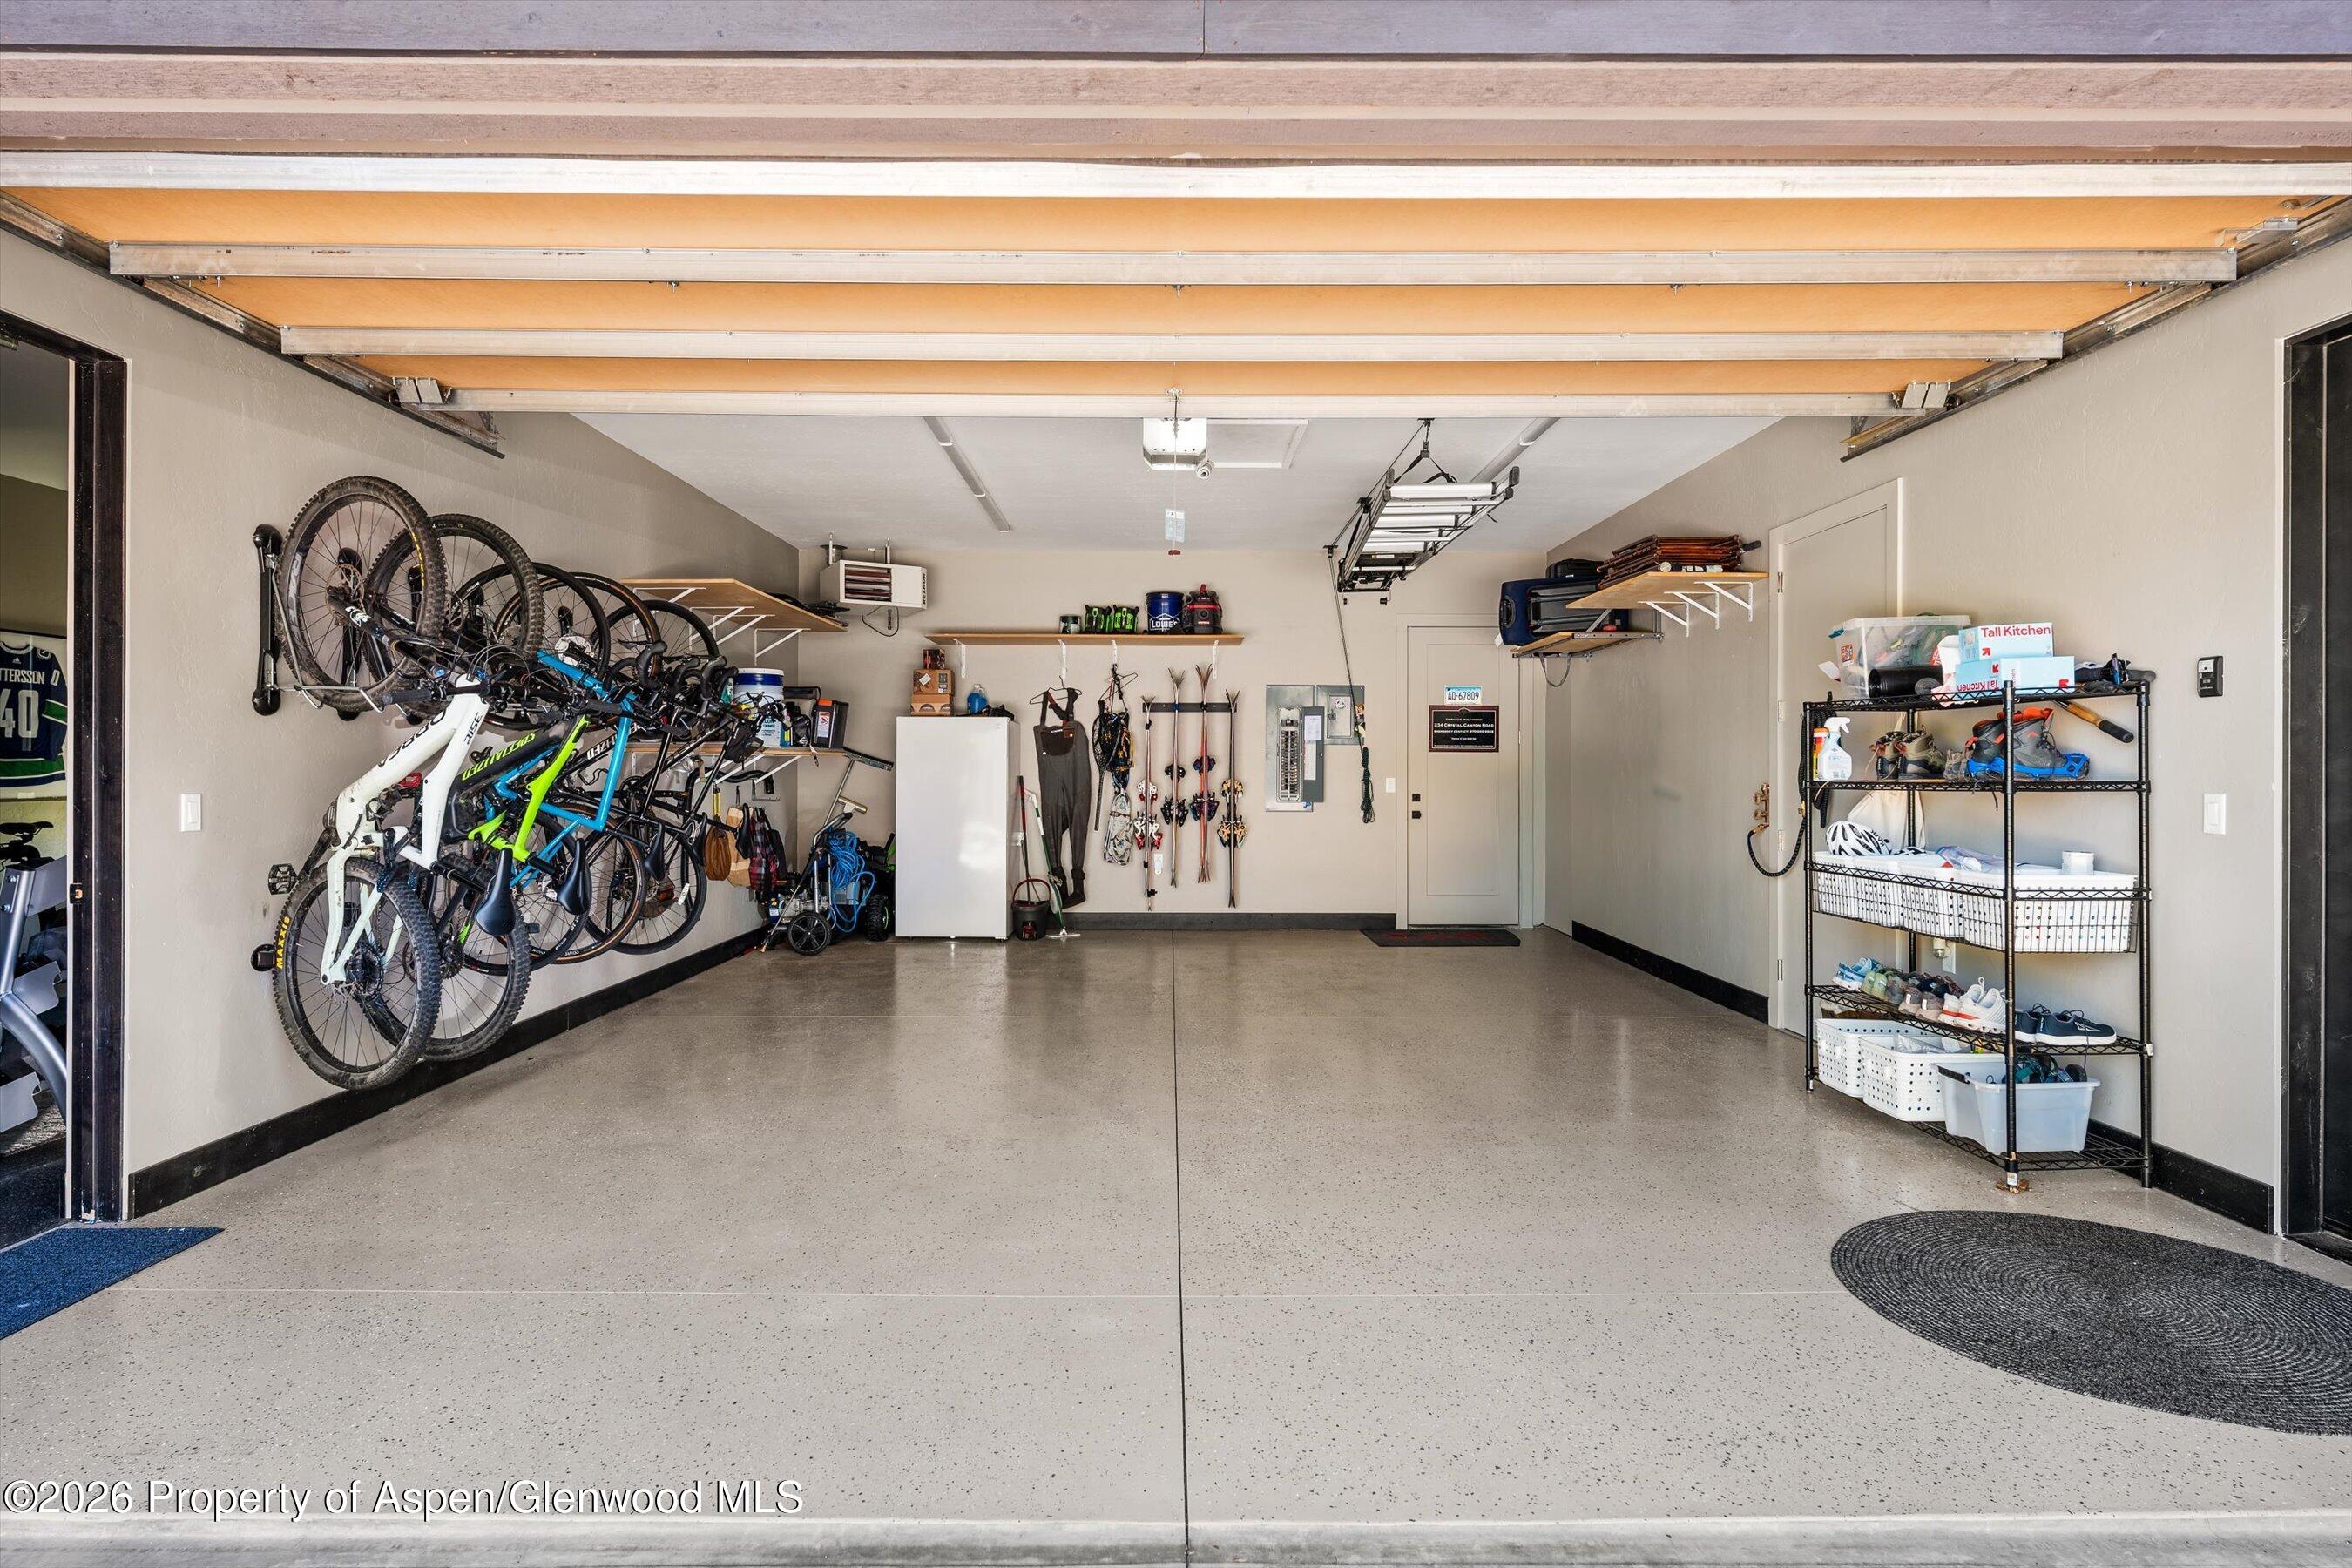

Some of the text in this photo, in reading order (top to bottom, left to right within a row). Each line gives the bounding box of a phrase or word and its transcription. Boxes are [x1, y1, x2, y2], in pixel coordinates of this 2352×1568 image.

[1981, 625, 2051, 638] Tall Kitchen
[1957, 680, 1986, 692] Kitchen
[0, 688, 40, 738] 40
[462, 733, 536, 781] SPECIALIZED
[276, 916, 291, 970] MAXXIS
